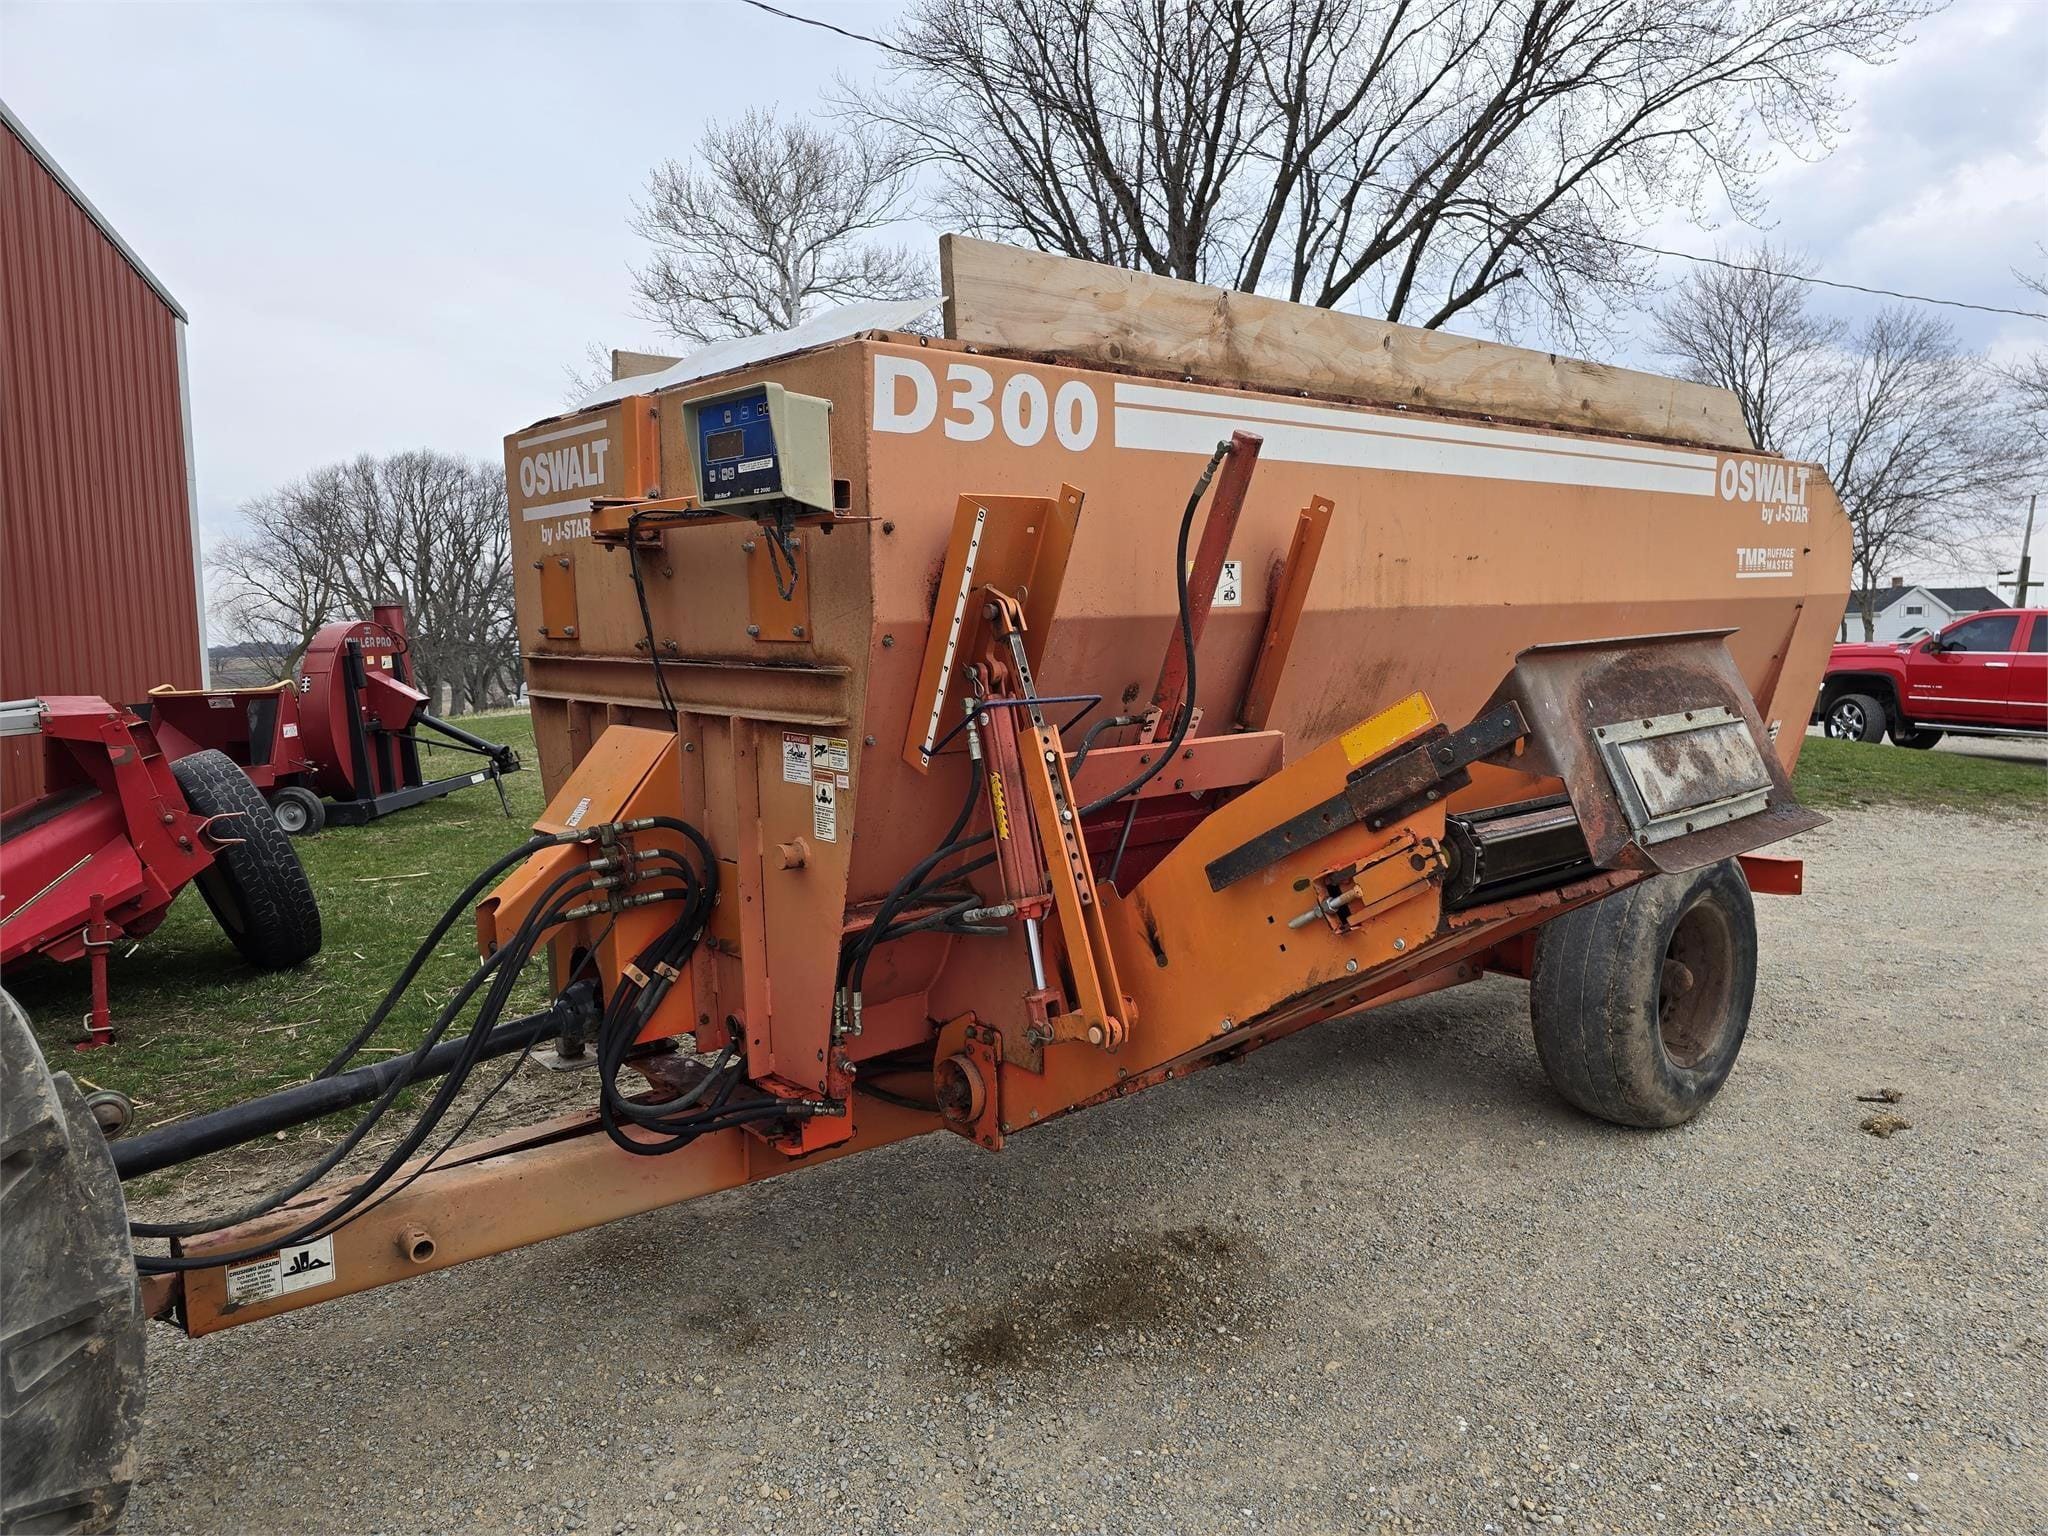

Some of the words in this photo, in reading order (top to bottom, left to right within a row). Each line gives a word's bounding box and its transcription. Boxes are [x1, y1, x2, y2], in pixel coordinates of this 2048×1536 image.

[872, 354, 1099, 452] D300
[519, 438, 608, 499] OSWALT
[1720, 459, 1810, 506] OSWALT
[1762, 504, 1774, 526] by
[1775, 505, 1808, 524] J-STAR
[541, 523, 553, 546] by
[554, 518, 592, 542] J-STAR
[1736, 547, 1767, 571] TMR
[1766, 559, 1794, 571] MASTER
[938, 688, 943, 696] 3
[944, 665, 949, 673] 4
[955, 616, 960, 624] 6
[960, 591, 965, 599] 7
[977, 511, 985, 523] 10
[376, 637, 393, 648] PRO
[229, 1266, 257, 1278] CRUSHING
[257, 1260, 280, 1270] HAZARD
[257, 1268, 273, 1276] WORK
[236, 1283, 260, 1291] MACHINE
